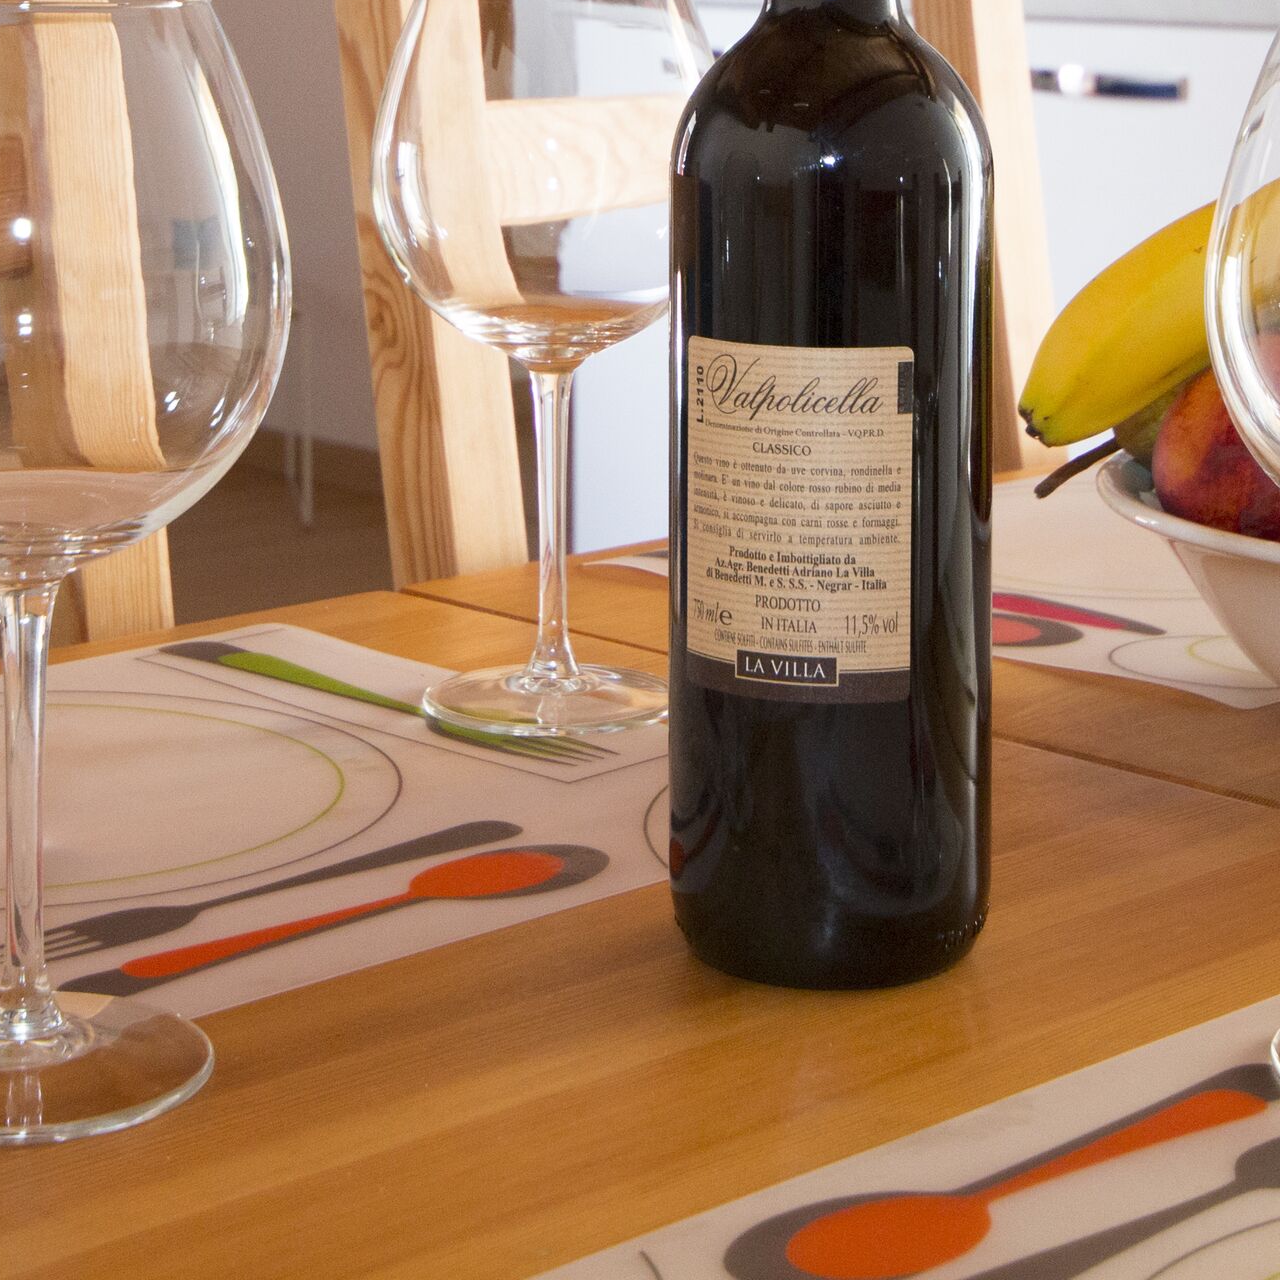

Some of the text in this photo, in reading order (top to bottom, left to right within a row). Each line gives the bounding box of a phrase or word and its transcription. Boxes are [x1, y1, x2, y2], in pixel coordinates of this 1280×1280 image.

[696, 365, 705, 424] L.2110
[705, 353, 884, 420] Valpolicella
[763, 426, 794, 437] Origine
[795, 428, 841, 438] Controllata
[752, 441, 812, 457] CLASSICO
[716, 457, 730, 468] vino
[740, 461, 772, 473] ottenuto
[776, 463, 786, 474] da
[791, 467, 806, 475] uve
[810, 465, 846, 477] corvina,
[850, 465, 893, 476] rondinella
[731, 478, 741, 486] un
[744, 479, 760, 489] vino
[763, 480, 776, 491] dal
[779, 481, 805, 493] colore
[809, 485, 831, 494] rosso
[834, 483, 862, 494] rubino
[865, 482, 874, 493] di
[877, 481, 902, 493] media
[731, 493, 756, 506] vinoso
[769, 497, 806, 511] delicato,
[810, 500, 820, 510] di
[825, 502, 854, 513] sapore
[858, 499, 892, 510] asciutto
[723, 507, 729, 519] si
[732, 512, 778, 527] accompagna
[781, 518, 797, 527] con
[800, 516, 822, 528] carni
[826, 519, 848, 528] rosse
[702, 521, 732, 538] consiglia
[736, 527, 744, 539] di
[749, 530, 782, 543] servirlo
[799, 535, 853, 548] temperatura
[859, 534, 901, 546] ambiente.
[728, 545, 856, 567] Prodotto e Imbottigliato da
[714, 557, 875, 578] Az.Agr. Benedetti Adriano La Villa
[705, 566, 713, 578] di
[714, 567, 752, 585] Benedetti
[754, 575, 767, 587] M.
[777, 577, 786, 589] S.
[817, 580, 853, 593] Negrar
[861, 579, 887, 591] Italia
[754, 594, 821, 613] PRODOTTO
[761, 616, 817, 634] IN ITALIA
[844, 610, 899, 639] 11,5% vol
[759, 634, 788, 651] CONTAINS
[788, 637, 813, 653] SULFITES
[845, 640, 867, 654] SULFITE
[745, 656, 826, 679] LA VILLA
